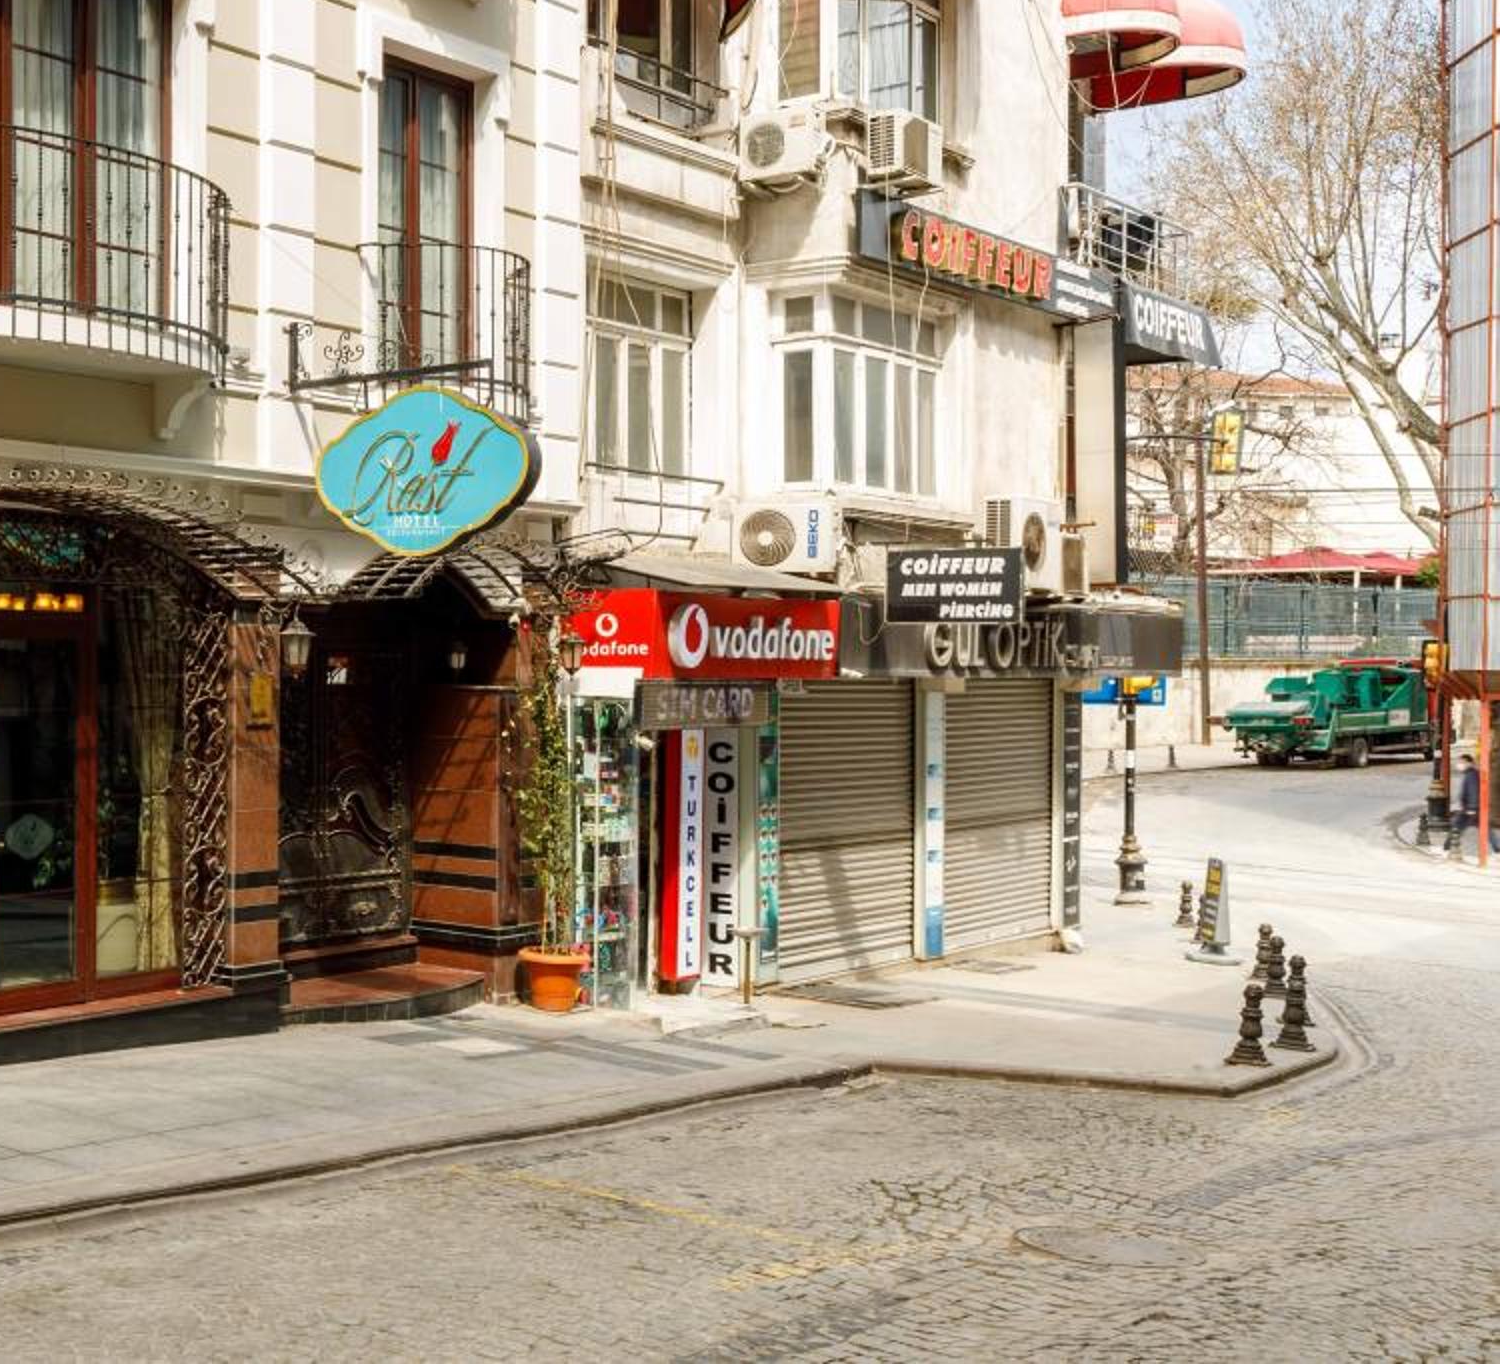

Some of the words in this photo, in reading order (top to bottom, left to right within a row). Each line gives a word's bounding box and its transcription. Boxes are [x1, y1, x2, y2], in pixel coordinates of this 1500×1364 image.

[901, 209, 1052, 301] COIFFEUR
[1133, 293, 1205, 351] COIFFEUR
[901, 582, 937, 597] MEN
[715, 615, 835, 661] vodafone
[703, 687, 755, 719] CARD
[685, 774, 697, 968] TURKCELL
